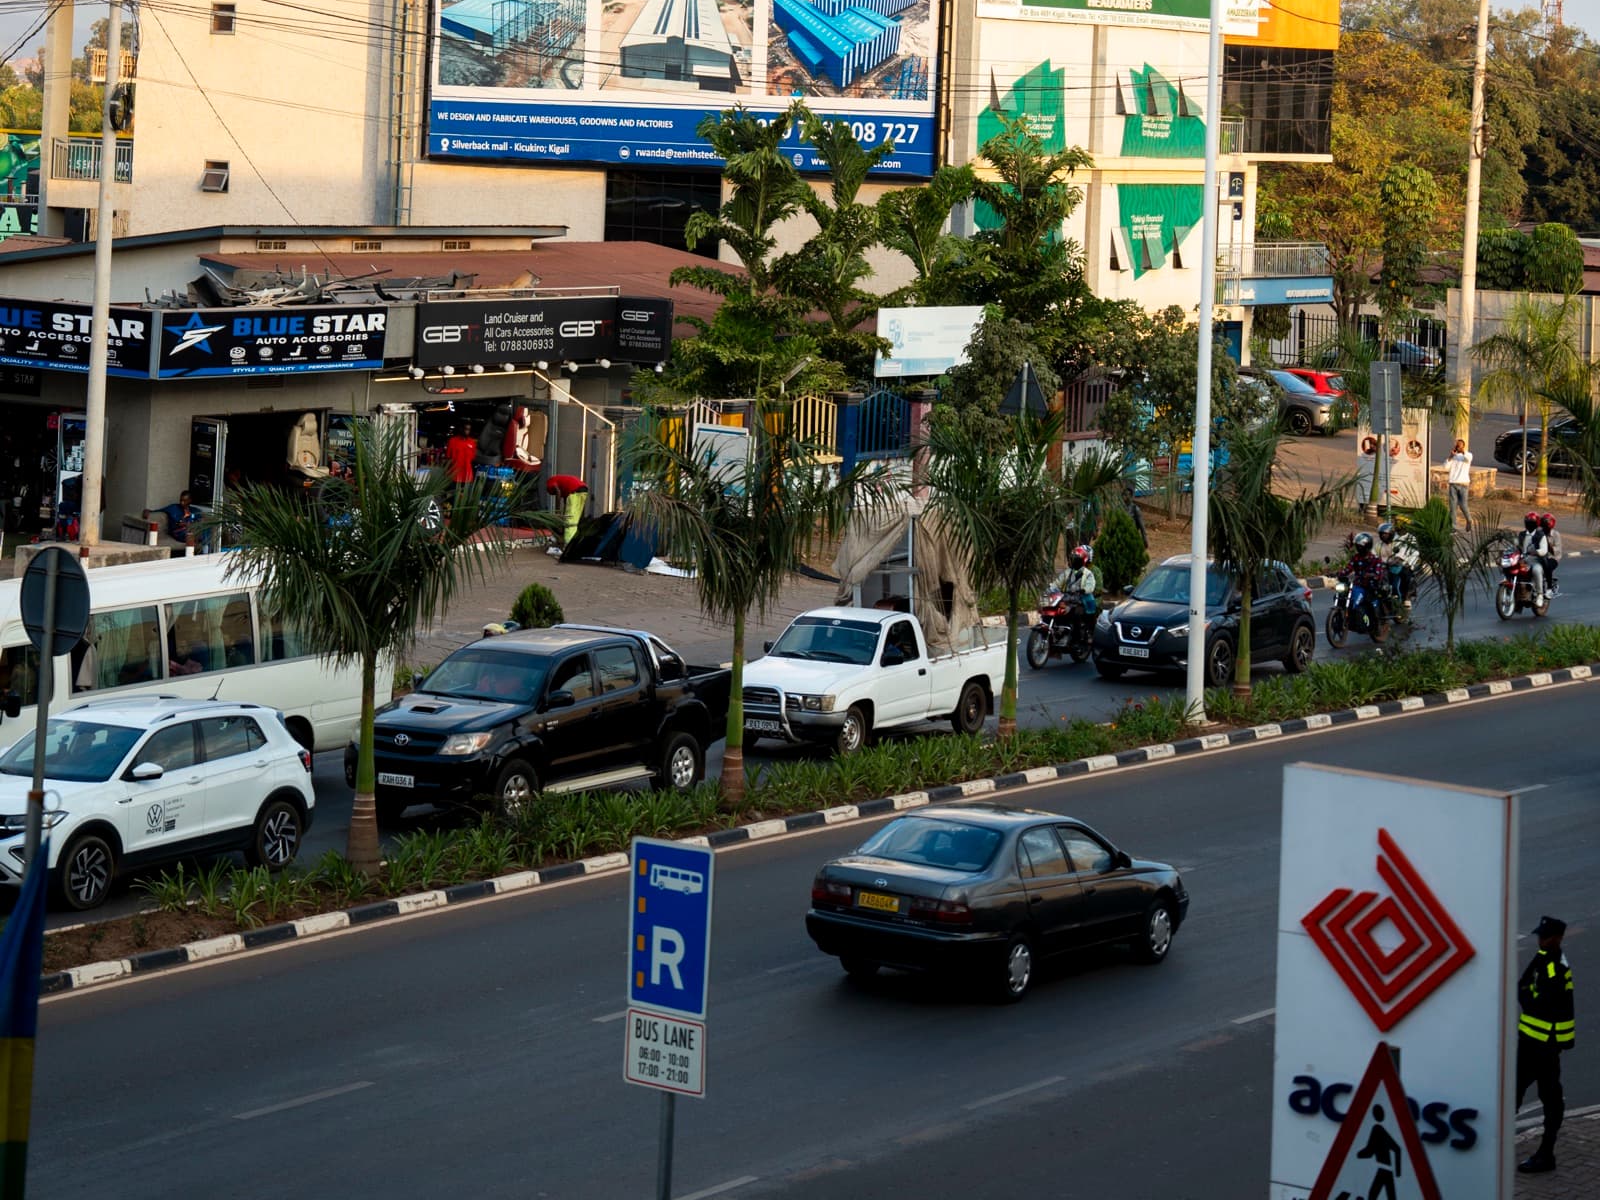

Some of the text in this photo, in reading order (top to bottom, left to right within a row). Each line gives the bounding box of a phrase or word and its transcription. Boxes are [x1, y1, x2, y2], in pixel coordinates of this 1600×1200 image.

[437, 112, 674, 129] WE DESIGN AND FABRICATE WAREHOUSES, GODOWNS AND FACTORIES
[882, 123, 920, 144] 727
[452, 140, 490, 150] Silverback
[492, 142, 508, 151] mall
[549, 144, 570, 155] Kigali
[52, 313, 145, 340] STAR
[233, 313, 386, 336] BLUE STAR
[484, 311, 543, 324] Land Cruiser and
[27, 330, 124, 346] ACCESSOES
[256, 333, 368, 345] AUTO ACCESSORIES
[484, 327, 554, 338] All Cars Accessories
[484, 339, 554, 352] Tel: 0788306933
[49, 362, 90, 371] PERFORMA
[651, 925, 685, 990] R
[635, 1017, 695, 1050] BUS LANE
[639, 1046, 661, 1063] 06:00
[668, 1051, 689, 1069] 10:00
[637, 1061, 659, 1078] 17:00
[666, 1067, 689, 1085] 21:00
[1288, 1074, 1479, 1151] acss
